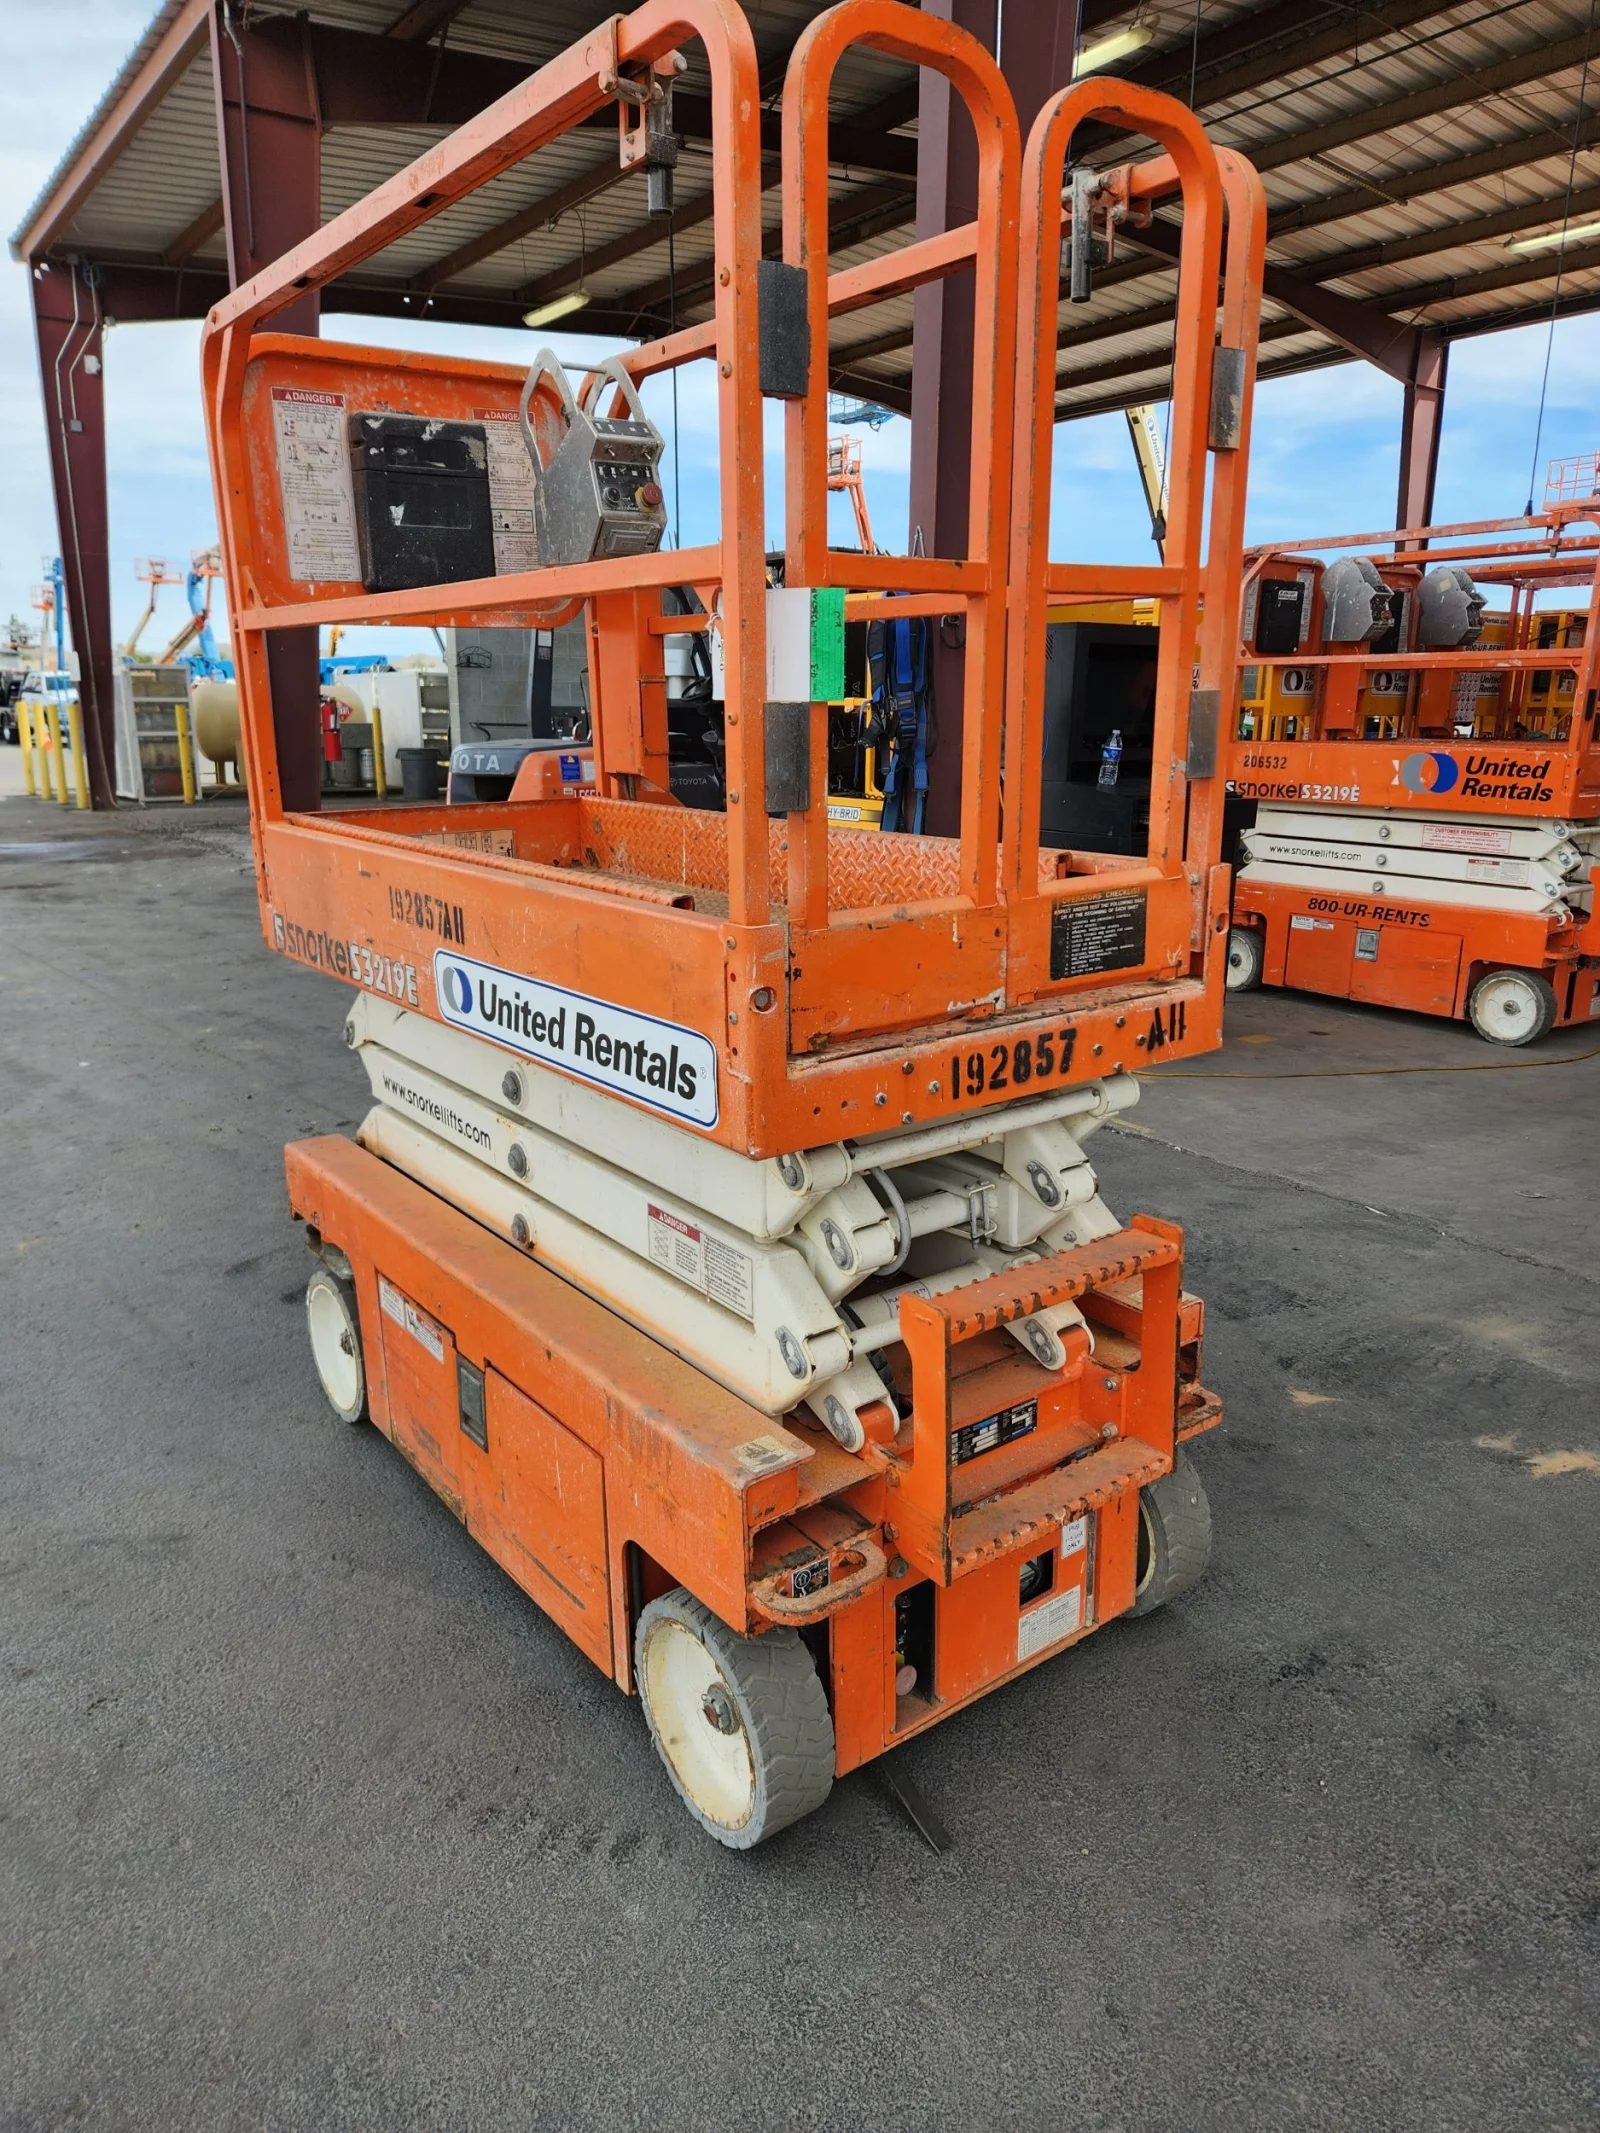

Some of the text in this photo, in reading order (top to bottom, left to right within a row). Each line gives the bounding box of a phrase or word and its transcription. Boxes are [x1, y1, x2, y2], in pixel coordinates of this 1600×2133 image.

[490, 410, 521, 421] DANGE
[1243, 755, 1288, 770] 206532
[1464, 755, 1551, 780] United
[678, 777, 708, 786] TOYOTA
[1460, 776, 1554, 802] Rentals
[1301, 784, 1360, 802] S3219E
[1269, 844, 1362, 862] www.snorkellifts.com
[1306, 897, 1431, 927] 800-UR-RENTS
[349, 943, 419, 1007] S3219E
[478, 978, 697, 1101] United Rentals
[952, 1027, 1077, 1100] 192857
[383, 1073, 492, 1150] www.snorkellifts.com
[663, 1214, 688, 1234] DANGER
[1067, 1539, 1081, 1551] ONLY
